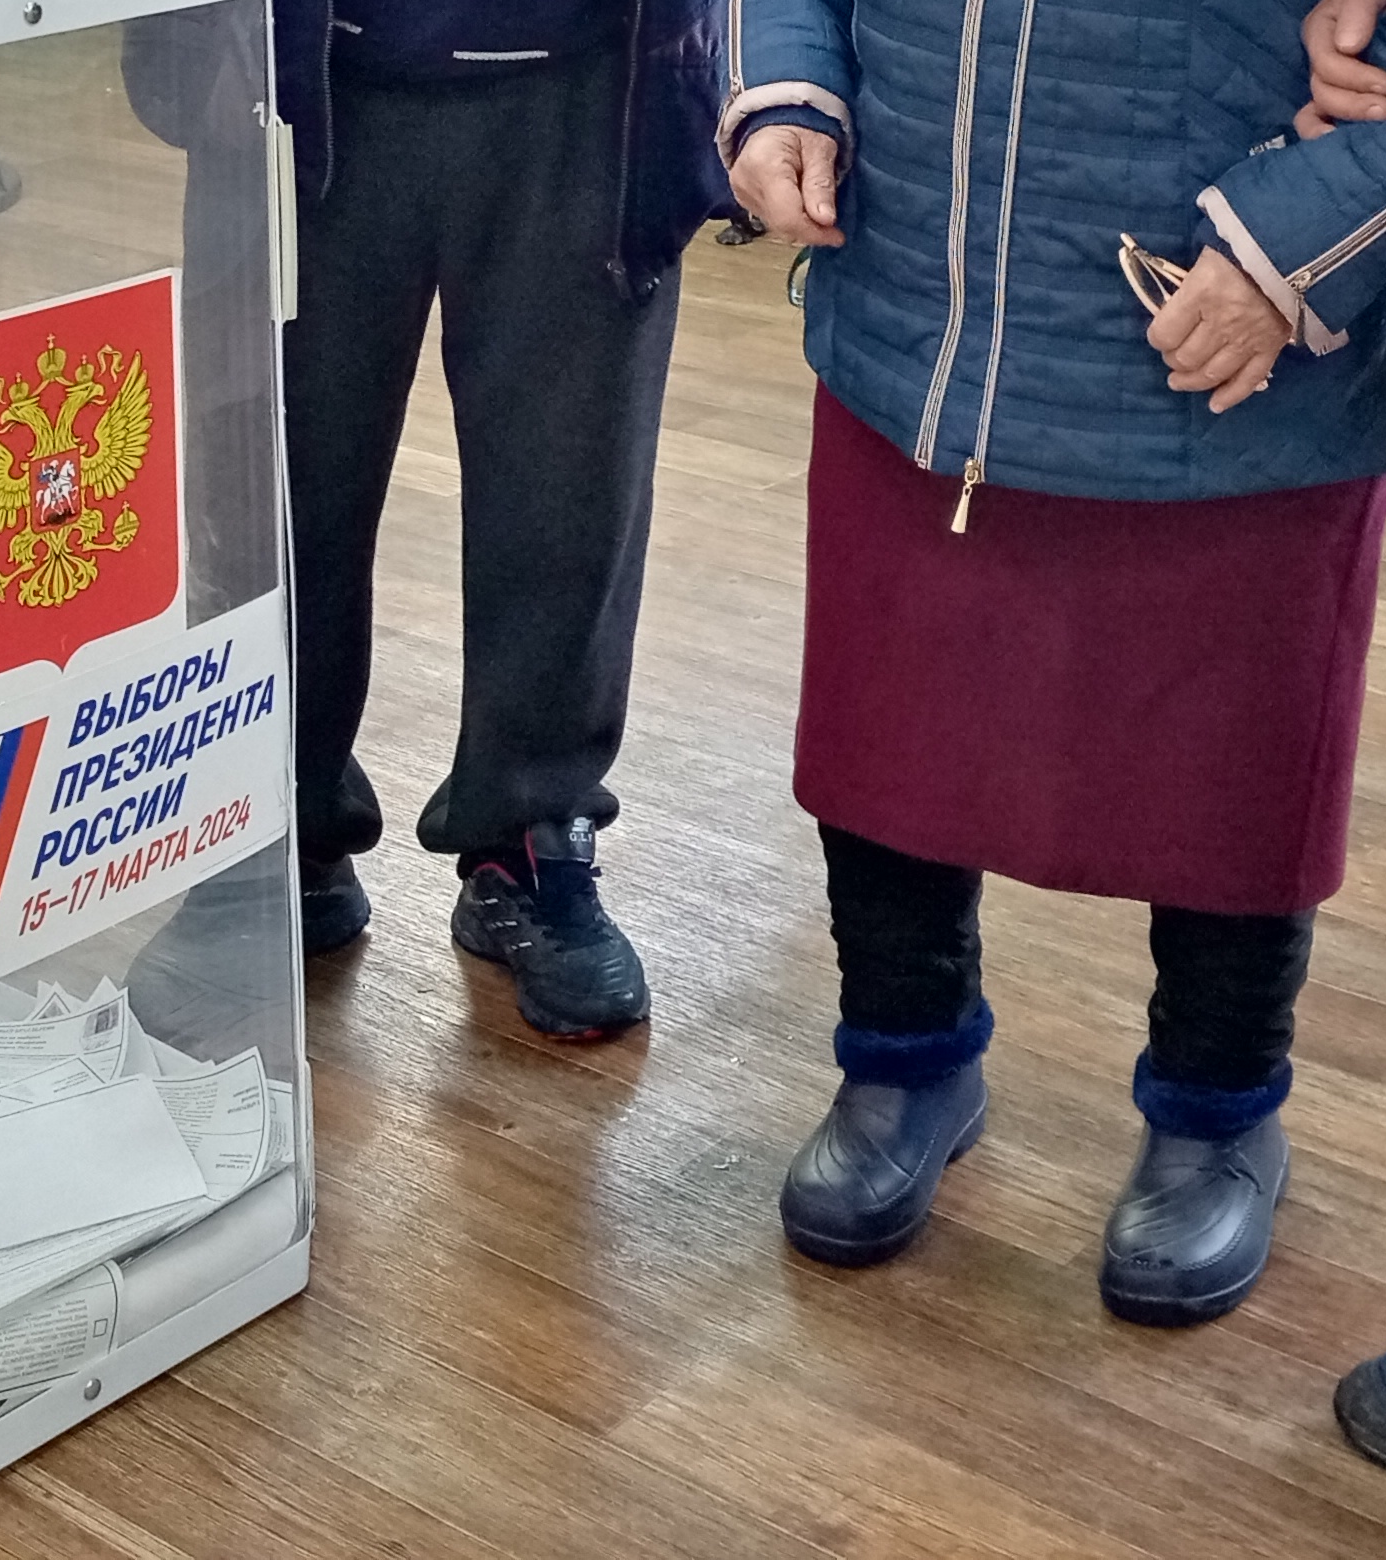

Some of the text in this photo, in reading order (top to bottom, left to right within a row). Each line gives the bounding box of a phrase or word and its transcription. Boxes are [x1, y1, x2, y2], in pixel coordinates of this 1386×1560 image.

[49, 673, 276, 814] ПРЕЗИДЕНТА
[67, 638, 234, 749] ВЫБОРЫ
[31, 771, 189, 881] РОССИИ
[98, 825, 190, 901] МАРТА
[193, 793, 252, 856] 2024
